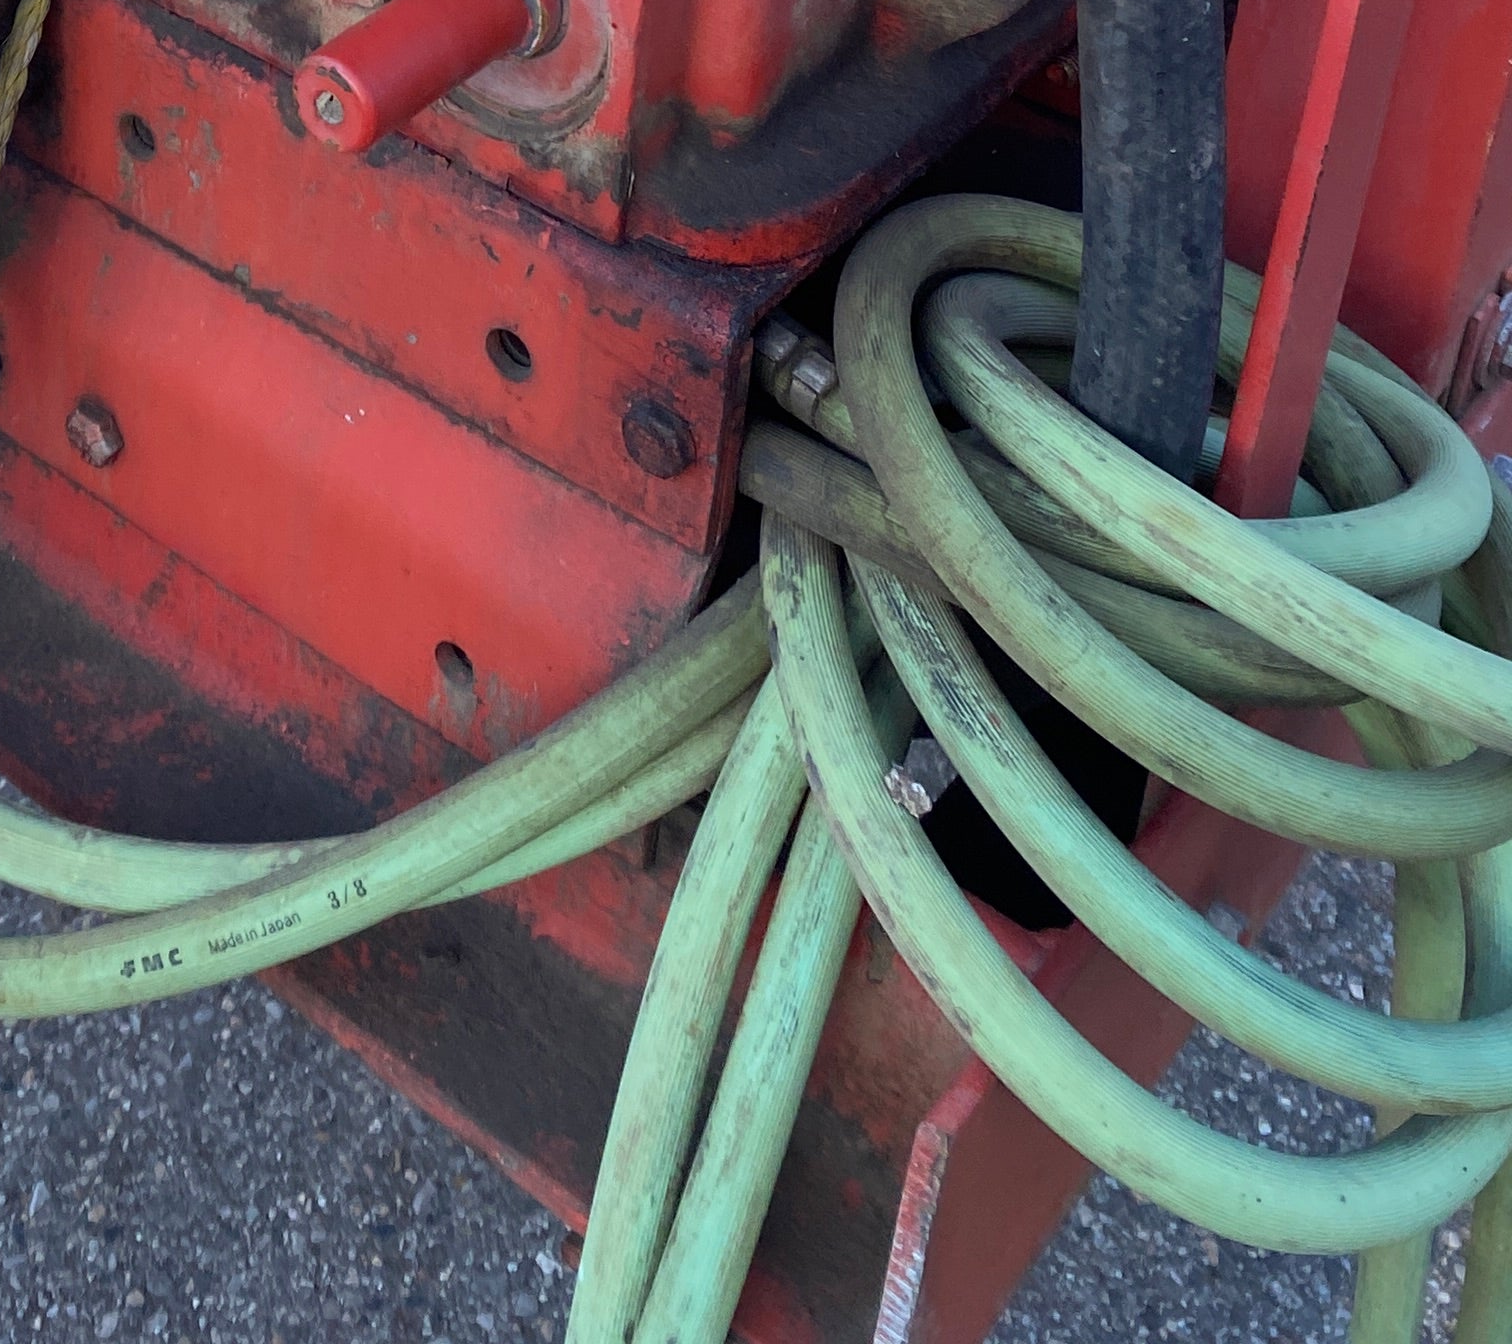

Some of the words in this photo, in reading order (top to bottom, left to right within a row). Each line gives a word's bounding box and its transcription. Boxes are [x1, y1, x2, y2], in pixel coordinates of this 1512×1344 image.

[207, 929, 243, 955] Made
[244, 926, 259, 944] in
[260, 911, 302, 938] Japan
